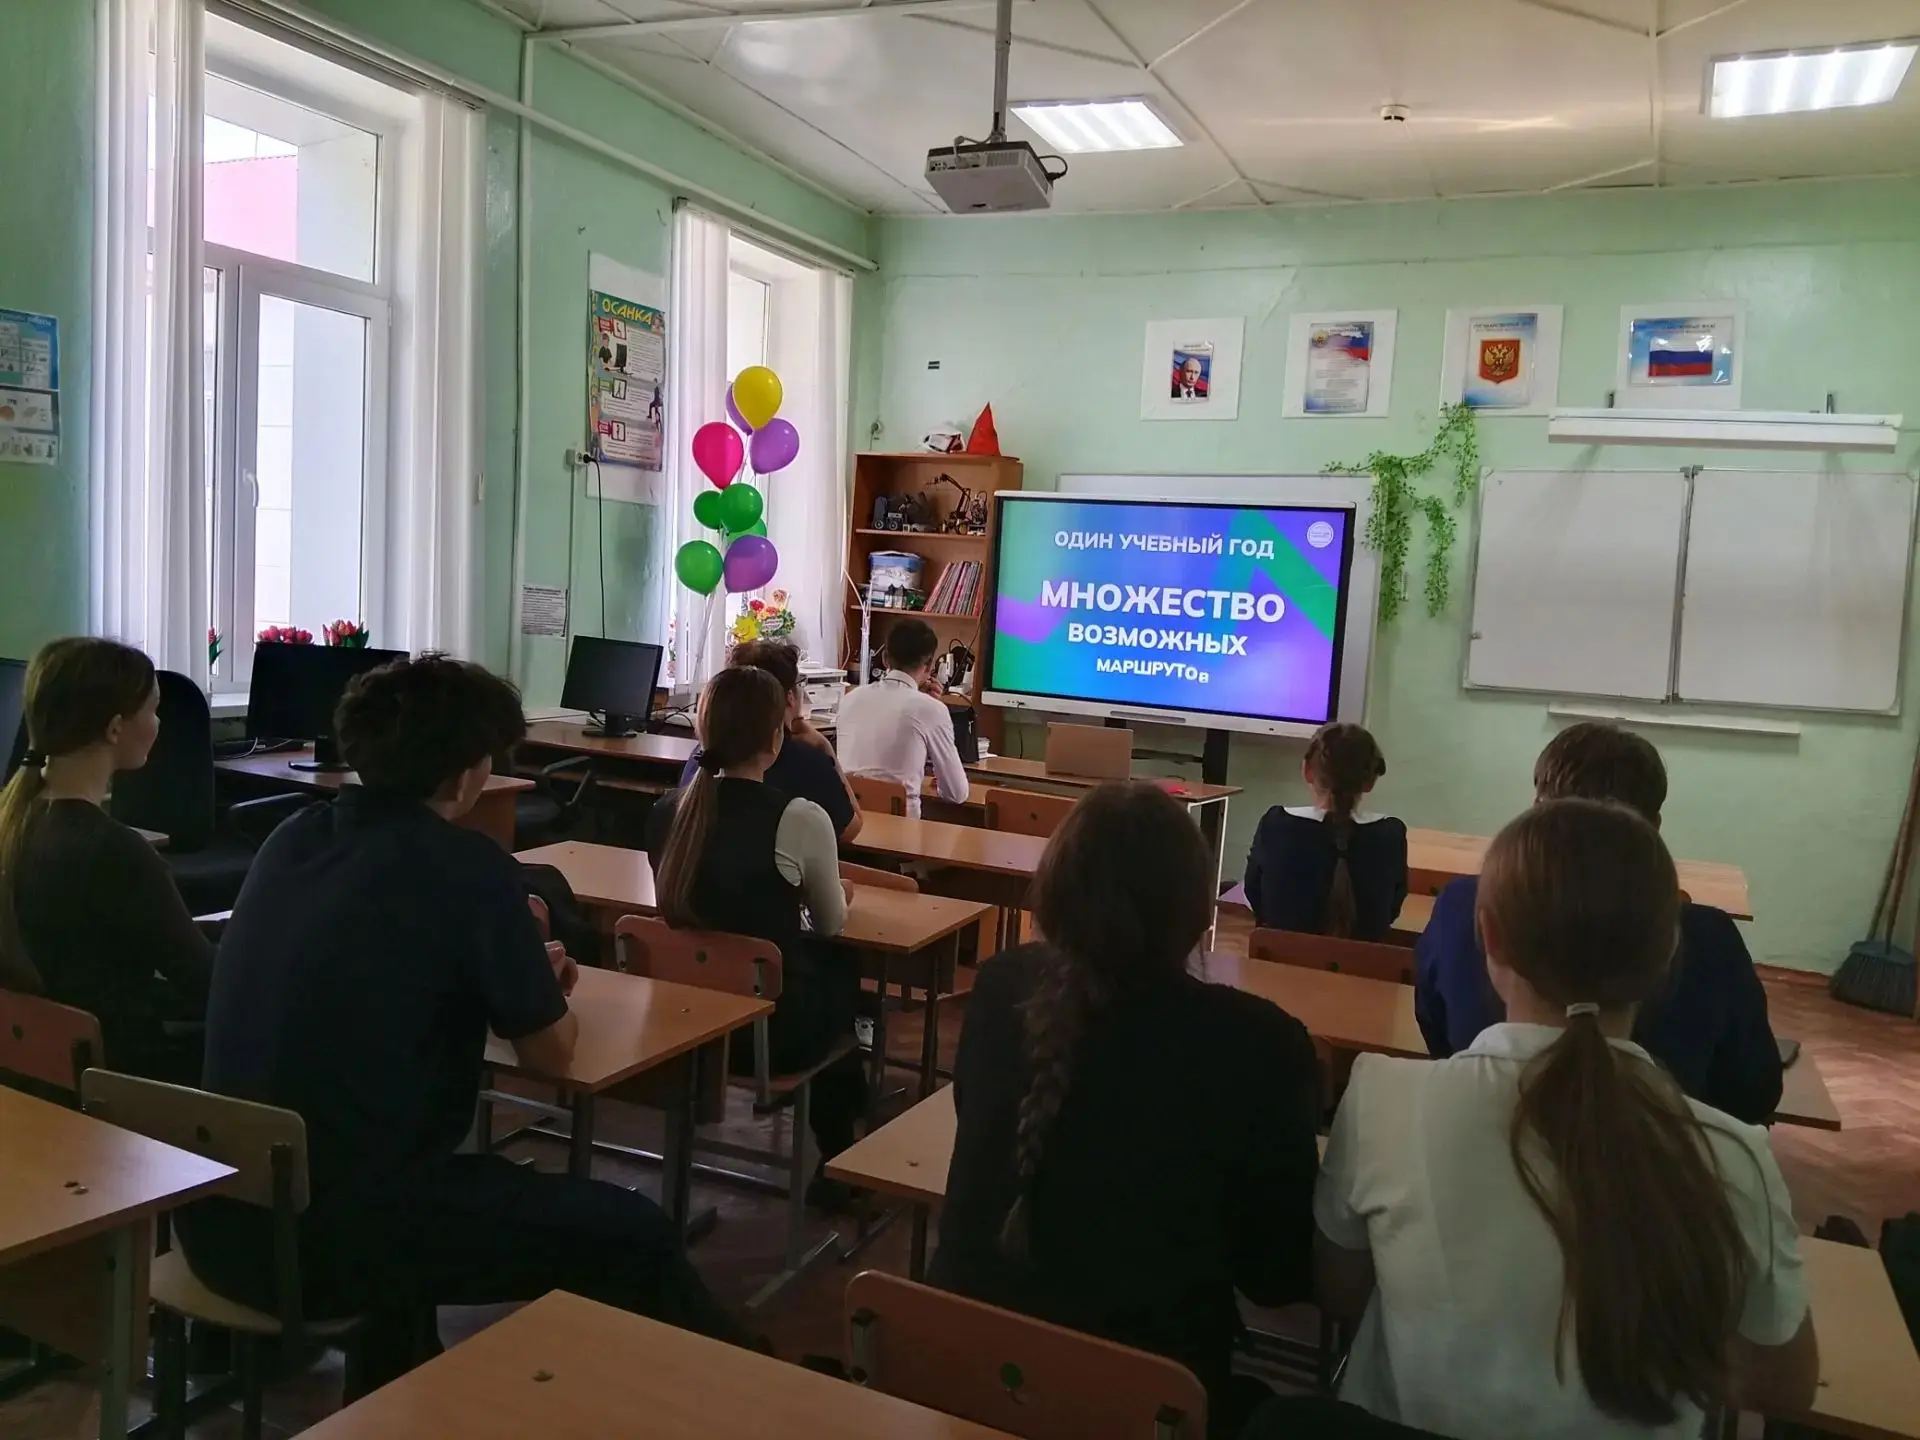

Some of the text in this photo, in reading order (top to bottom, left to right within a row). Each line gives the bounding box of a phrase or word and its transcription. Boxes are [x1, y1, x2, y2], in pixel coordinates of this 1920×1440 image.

[603, 298, 652, 325] ОСАНКА
[1055, 531, 1275, 559] ОДИН УЧЕБНЫЙ ГОД
[1041, 580, 1285, 623] МНОЖЕСТВО
[1068, 622, 1248, 656] ВОЗМОЖНЫХ
